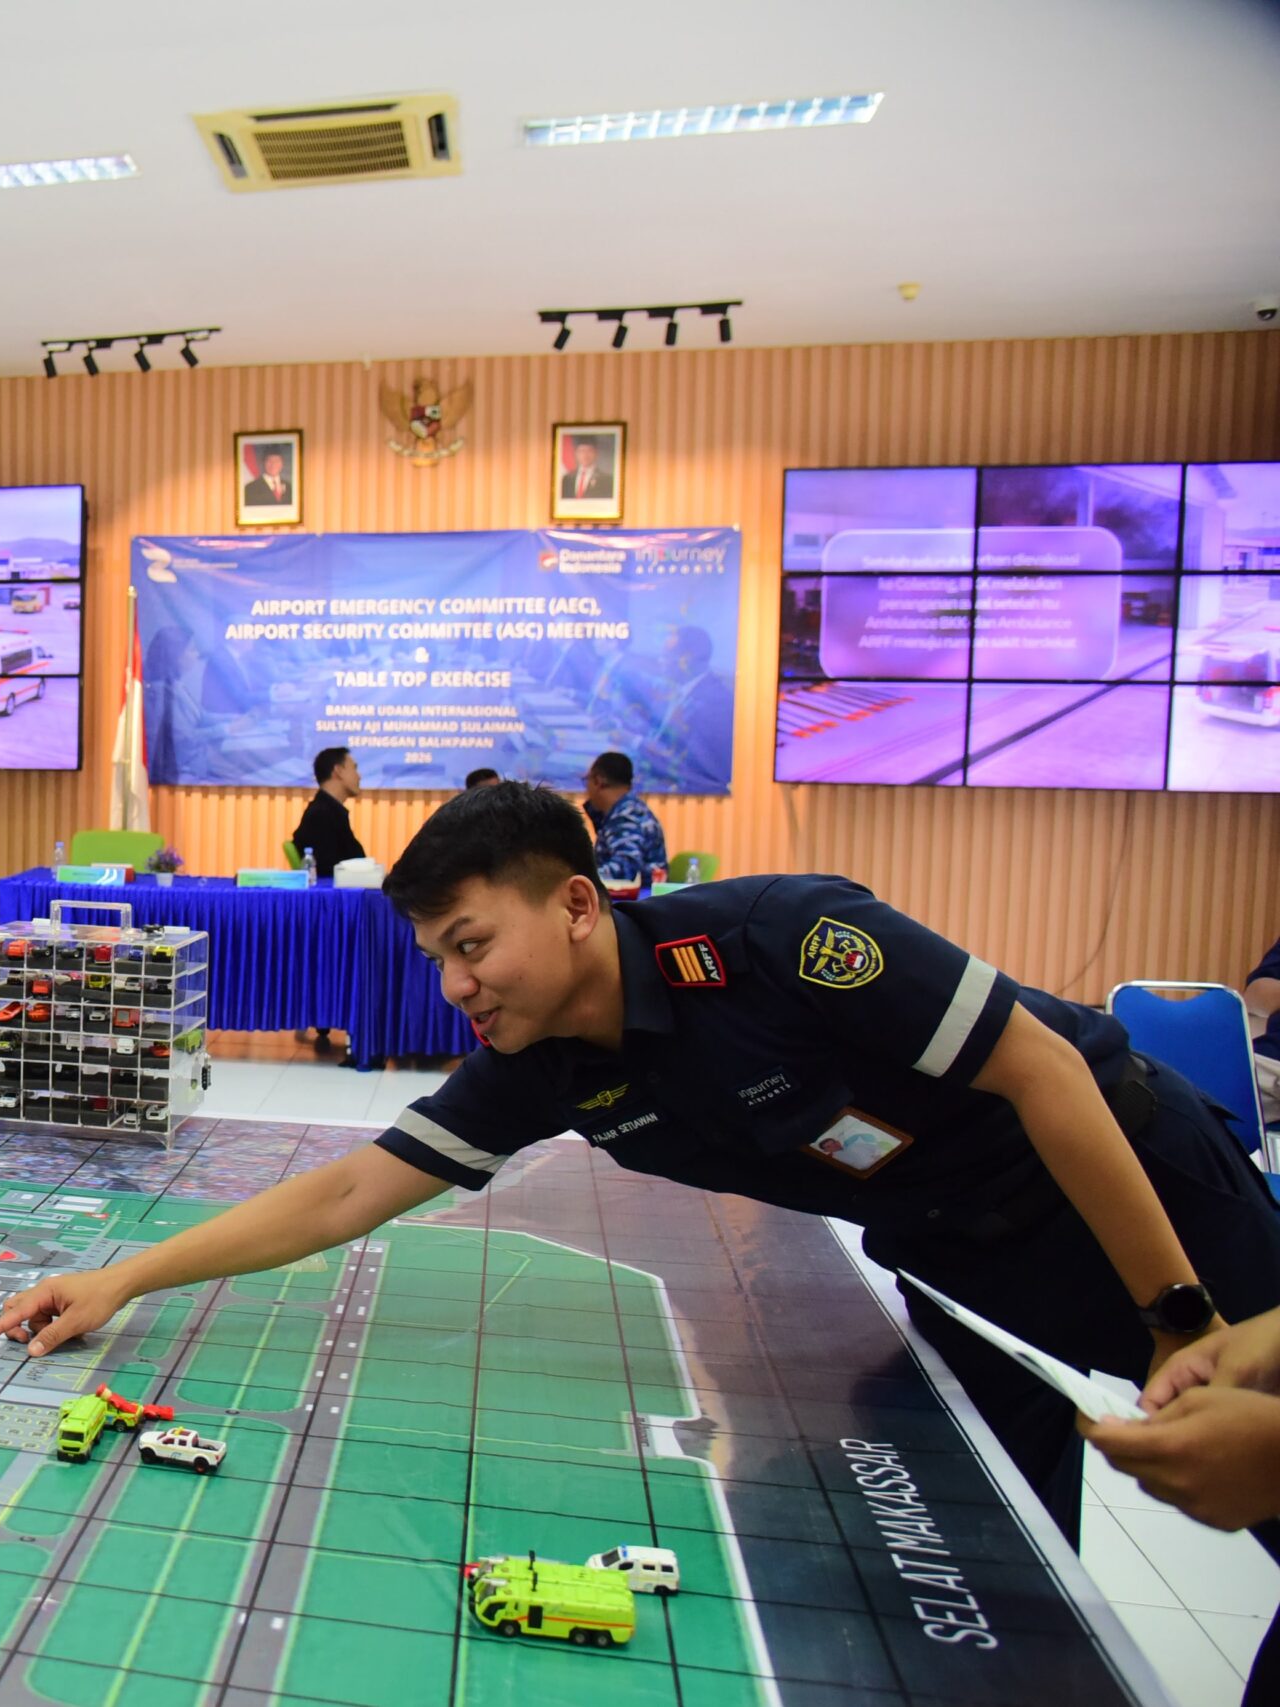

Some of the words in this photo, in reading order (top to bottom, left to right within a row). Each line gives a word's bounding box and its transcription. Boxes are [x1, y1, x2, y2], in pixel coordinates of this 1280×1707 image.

[251, 600, 327, 616] AIRPORT
[330, 598, 435, 615] EMERGENCY
[440, 597, 546, 615] COMMITTEE
[548, 597, 602, 616] (AEC),
[225, 624, 301, 640] AIRPORT
[302, 623, 385, 640] SECURITY
[388, 622, 494, 640] COMMITTEE
[496, 622, 544, 640] (ASC)
[547, 622, 630, 639] MEETING
[415, 646, 430, 664] &
[334, 671, 388, 688] TABLE
[391, 671, 427, 688] TOP
[430, 671, 512, 688] EXERCISE
[325, 704, 376, 717] BANDAR
[378, 705, 419, 717] UDARA
[421, 705, 518, 718] INTERNASIONAL
[316, 720, 362, 732] SULTAN
[383, 721, 459, 733] MUHAMMAD
[460, 721, 525, 733] SULAIMAN
[419, 737, 494, 748] BALIKPAPAN
[807, 934, 822, 959] ARFF
[698, 943, 721, 981] ARFF
[592, 1129, 619, 1144] FAJAR
[618, 1111, 659, 1135] SETIAWAN
[839, 1438, 951, 1556] MAKASSAR
[891, 1553, 998, 1650] SELAT
